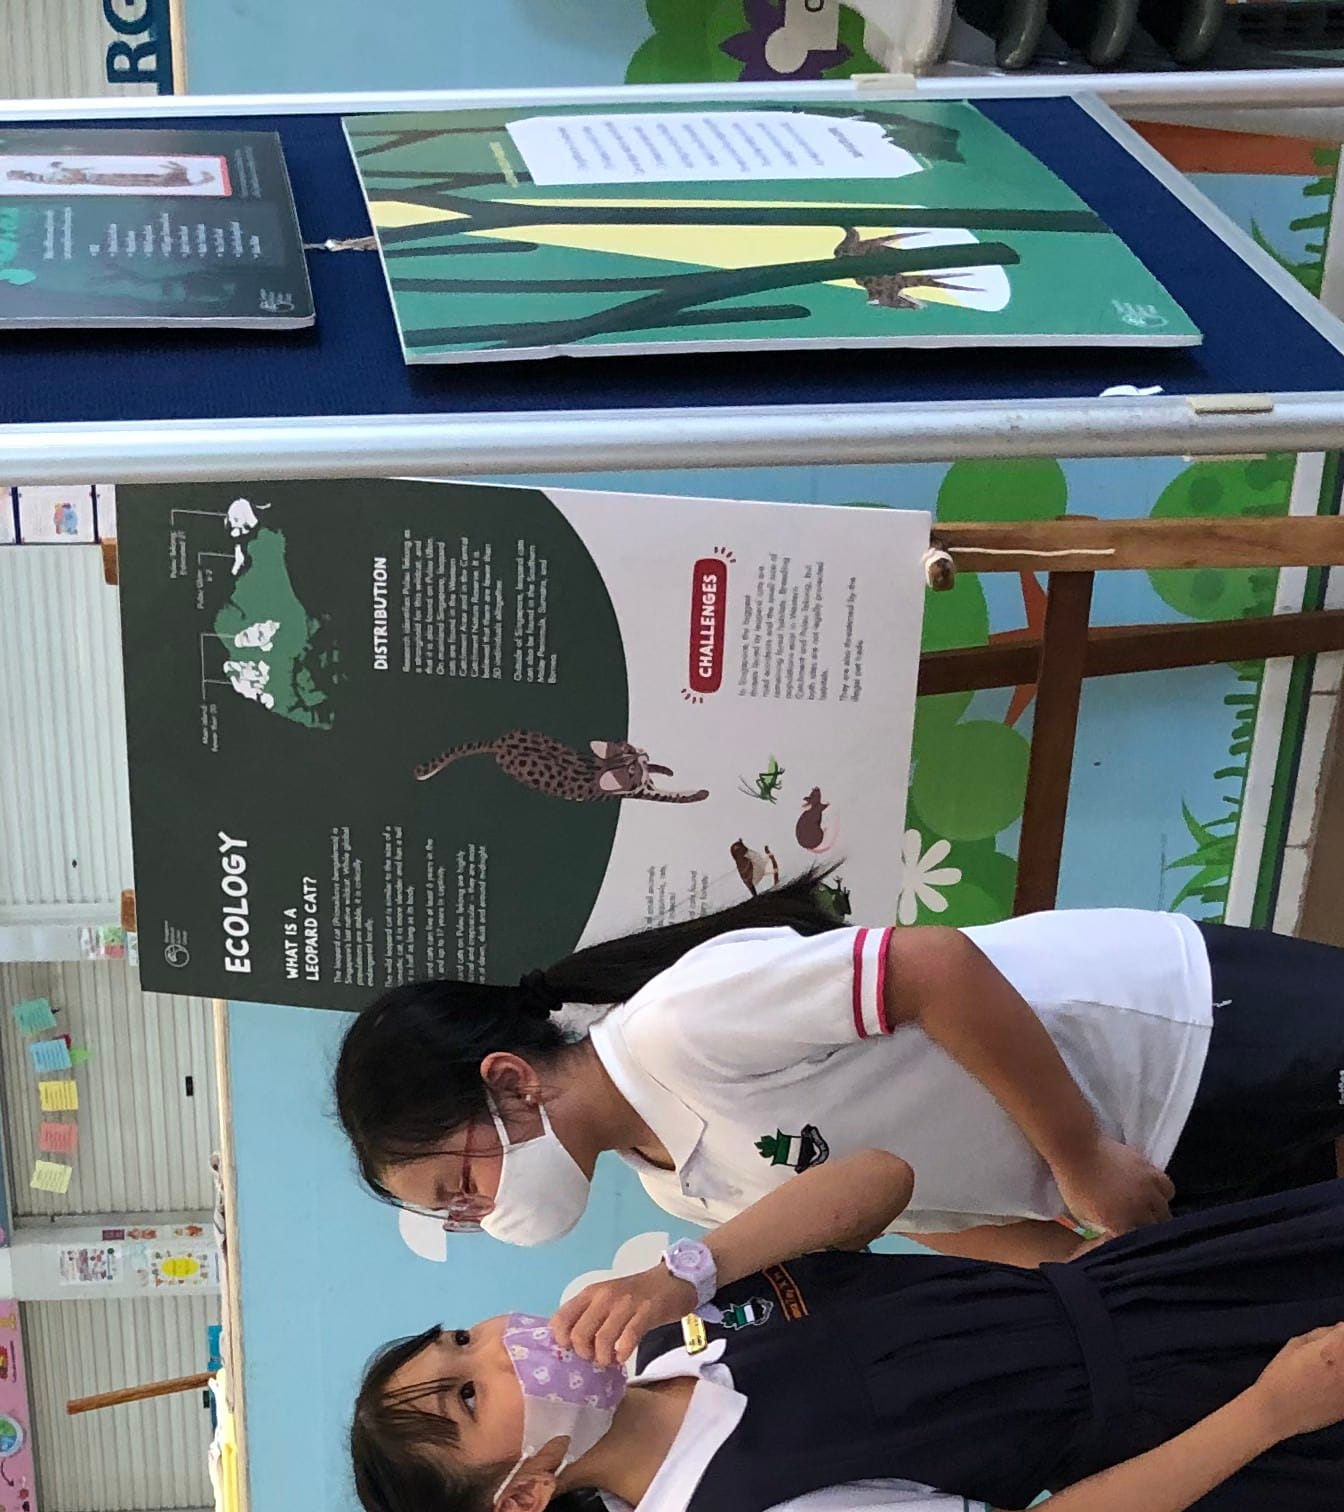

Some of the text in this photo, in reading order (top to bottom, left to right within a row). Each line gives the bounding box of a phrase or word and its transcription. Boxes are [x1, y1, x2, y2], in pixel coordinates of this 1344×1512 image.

[373, 557, 388, 670] DISTRIBUTION
[699, 574, 717, 678] CHALLENGES
[217, 831, 251, 973] ECOLOGY
[283, 908, 298, 979] WHAT IS A
[303, 876, 319, 981] LEOPARD CAT?
